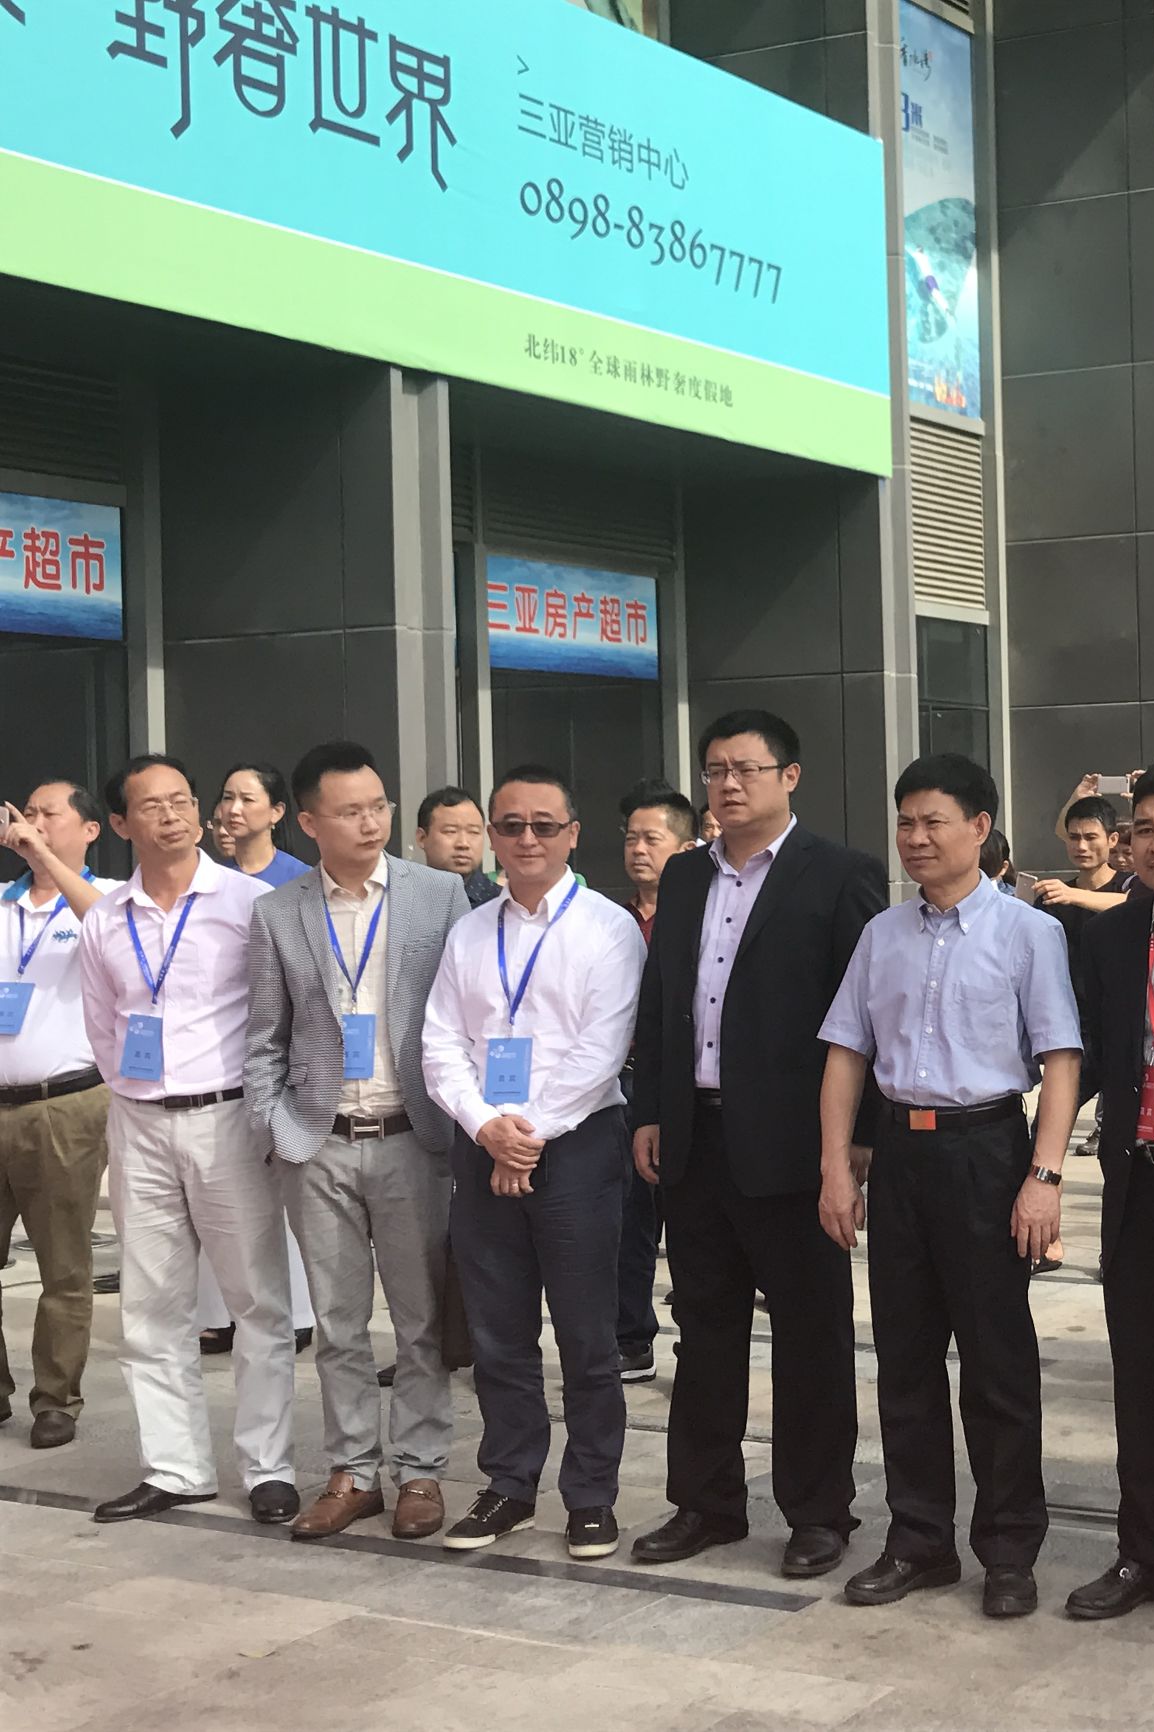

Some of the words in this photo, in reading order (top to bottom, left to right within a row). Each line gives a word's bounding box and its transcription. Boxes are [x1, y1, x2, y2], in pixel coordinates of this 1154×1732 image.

[0, 0, 457, 192] 野奢世界
[518, 92, 689, 190] 三亚营销中心
[520, 177, 783, 304] 0898-83867777
[486, 582, 649, 645] 三亚房产超市
